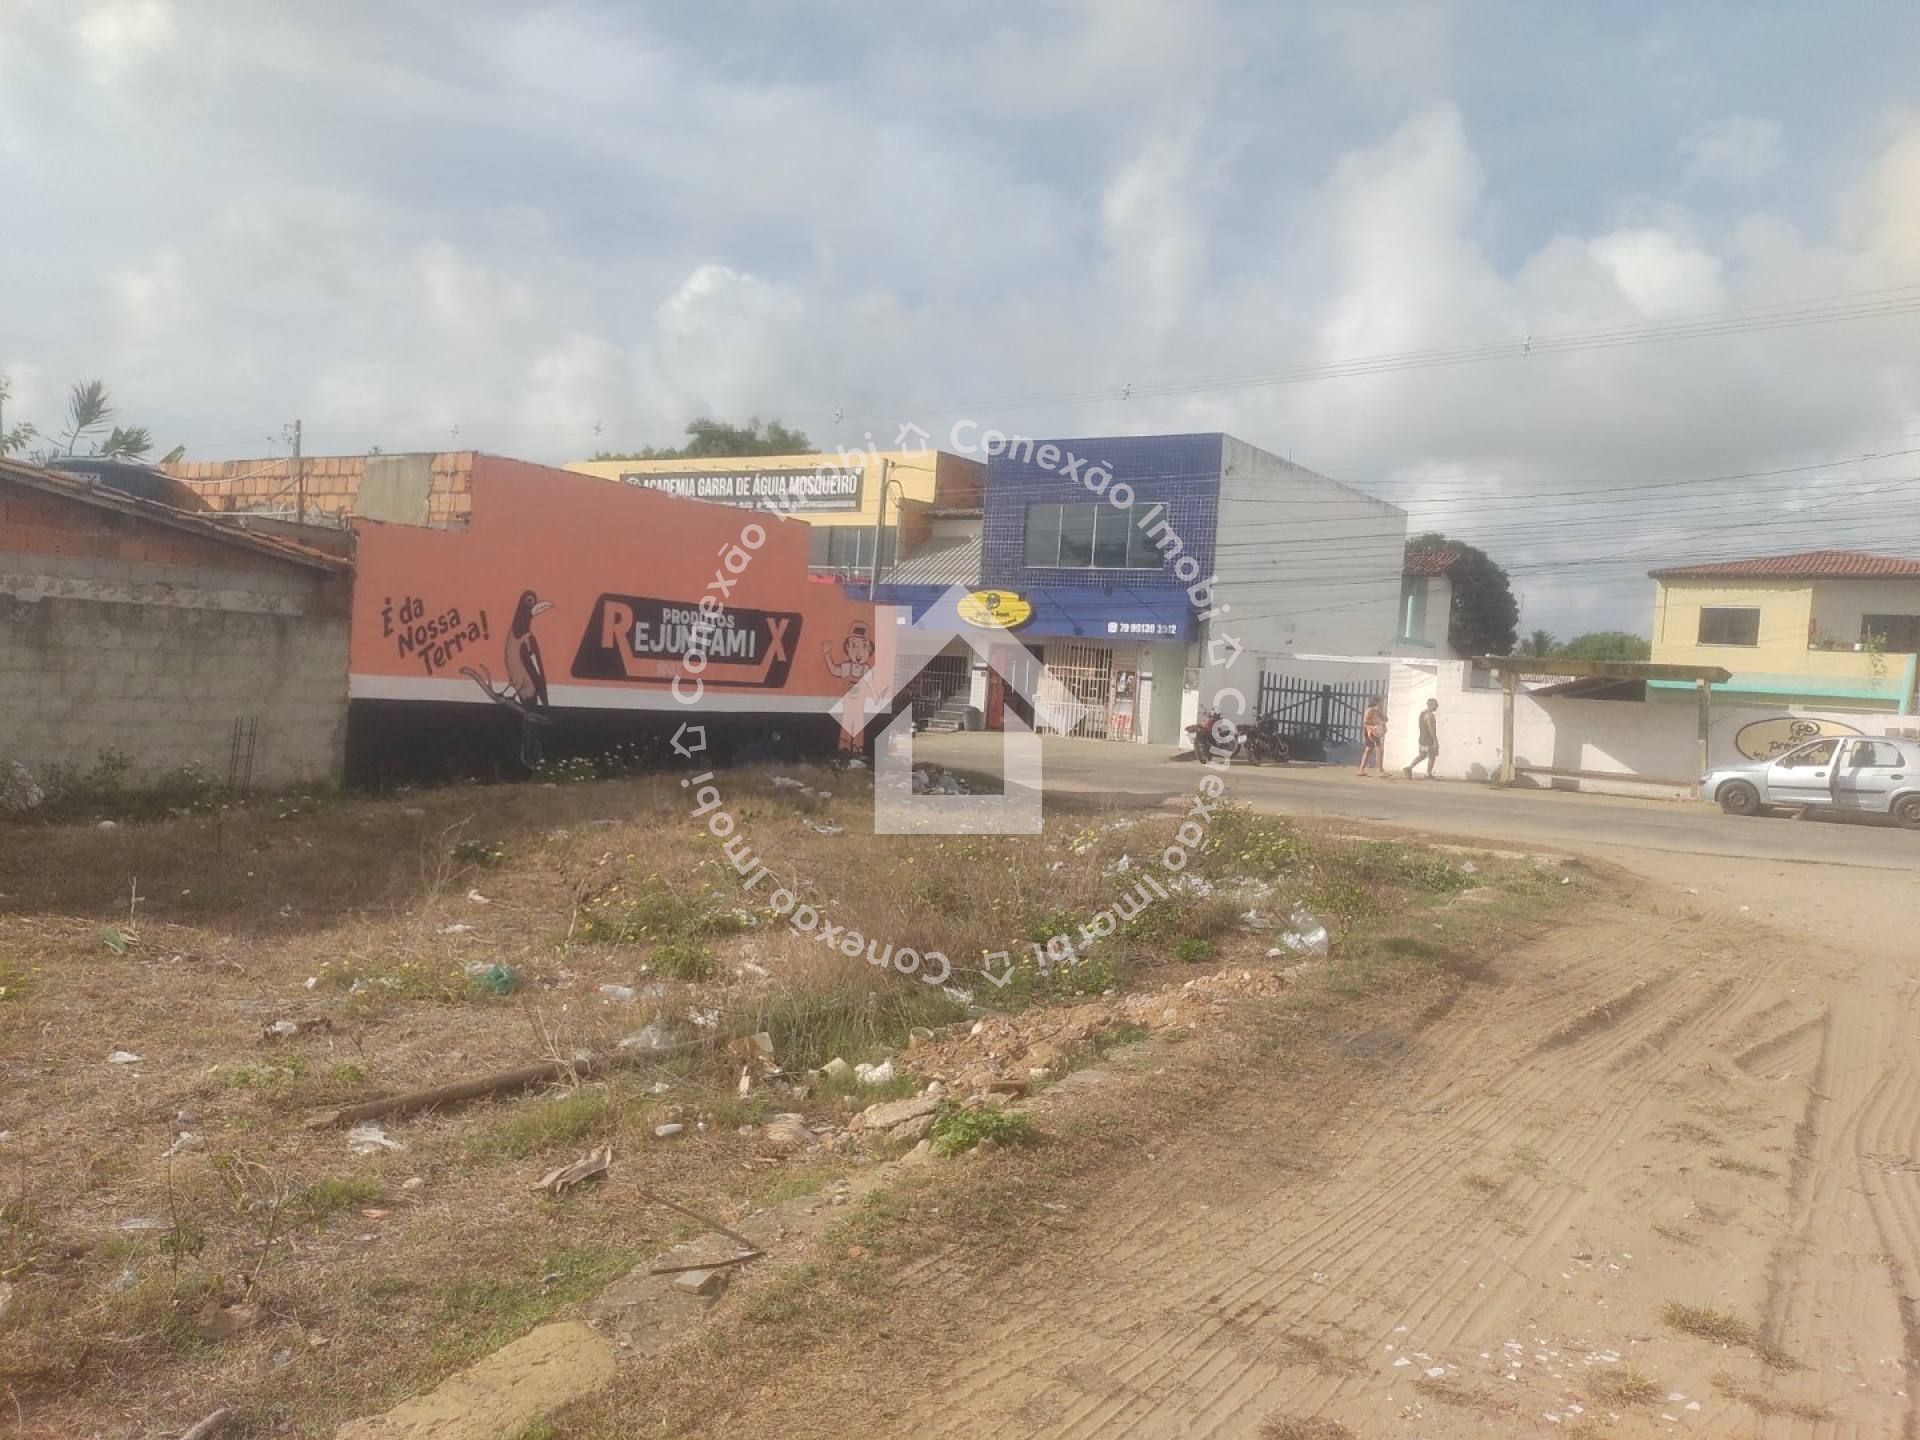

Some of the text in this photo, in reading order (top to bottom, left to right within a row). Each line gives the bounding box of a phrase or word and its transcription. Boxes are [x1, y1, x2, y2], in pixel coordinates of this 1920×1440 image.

[697, 476, 734, 497] GARRA
[735, 476, 750, 496] DE
[752, 473, 786, 496] ÁGUIA
[788, 475, 858, 495] MOSQUEIRO
[399, 596, 424, 625] da
[662, 607, 736, 629] PRODUTOS
[398, 608, 461, 659] Nossa
[418, 610, 489, 676] Terra!
